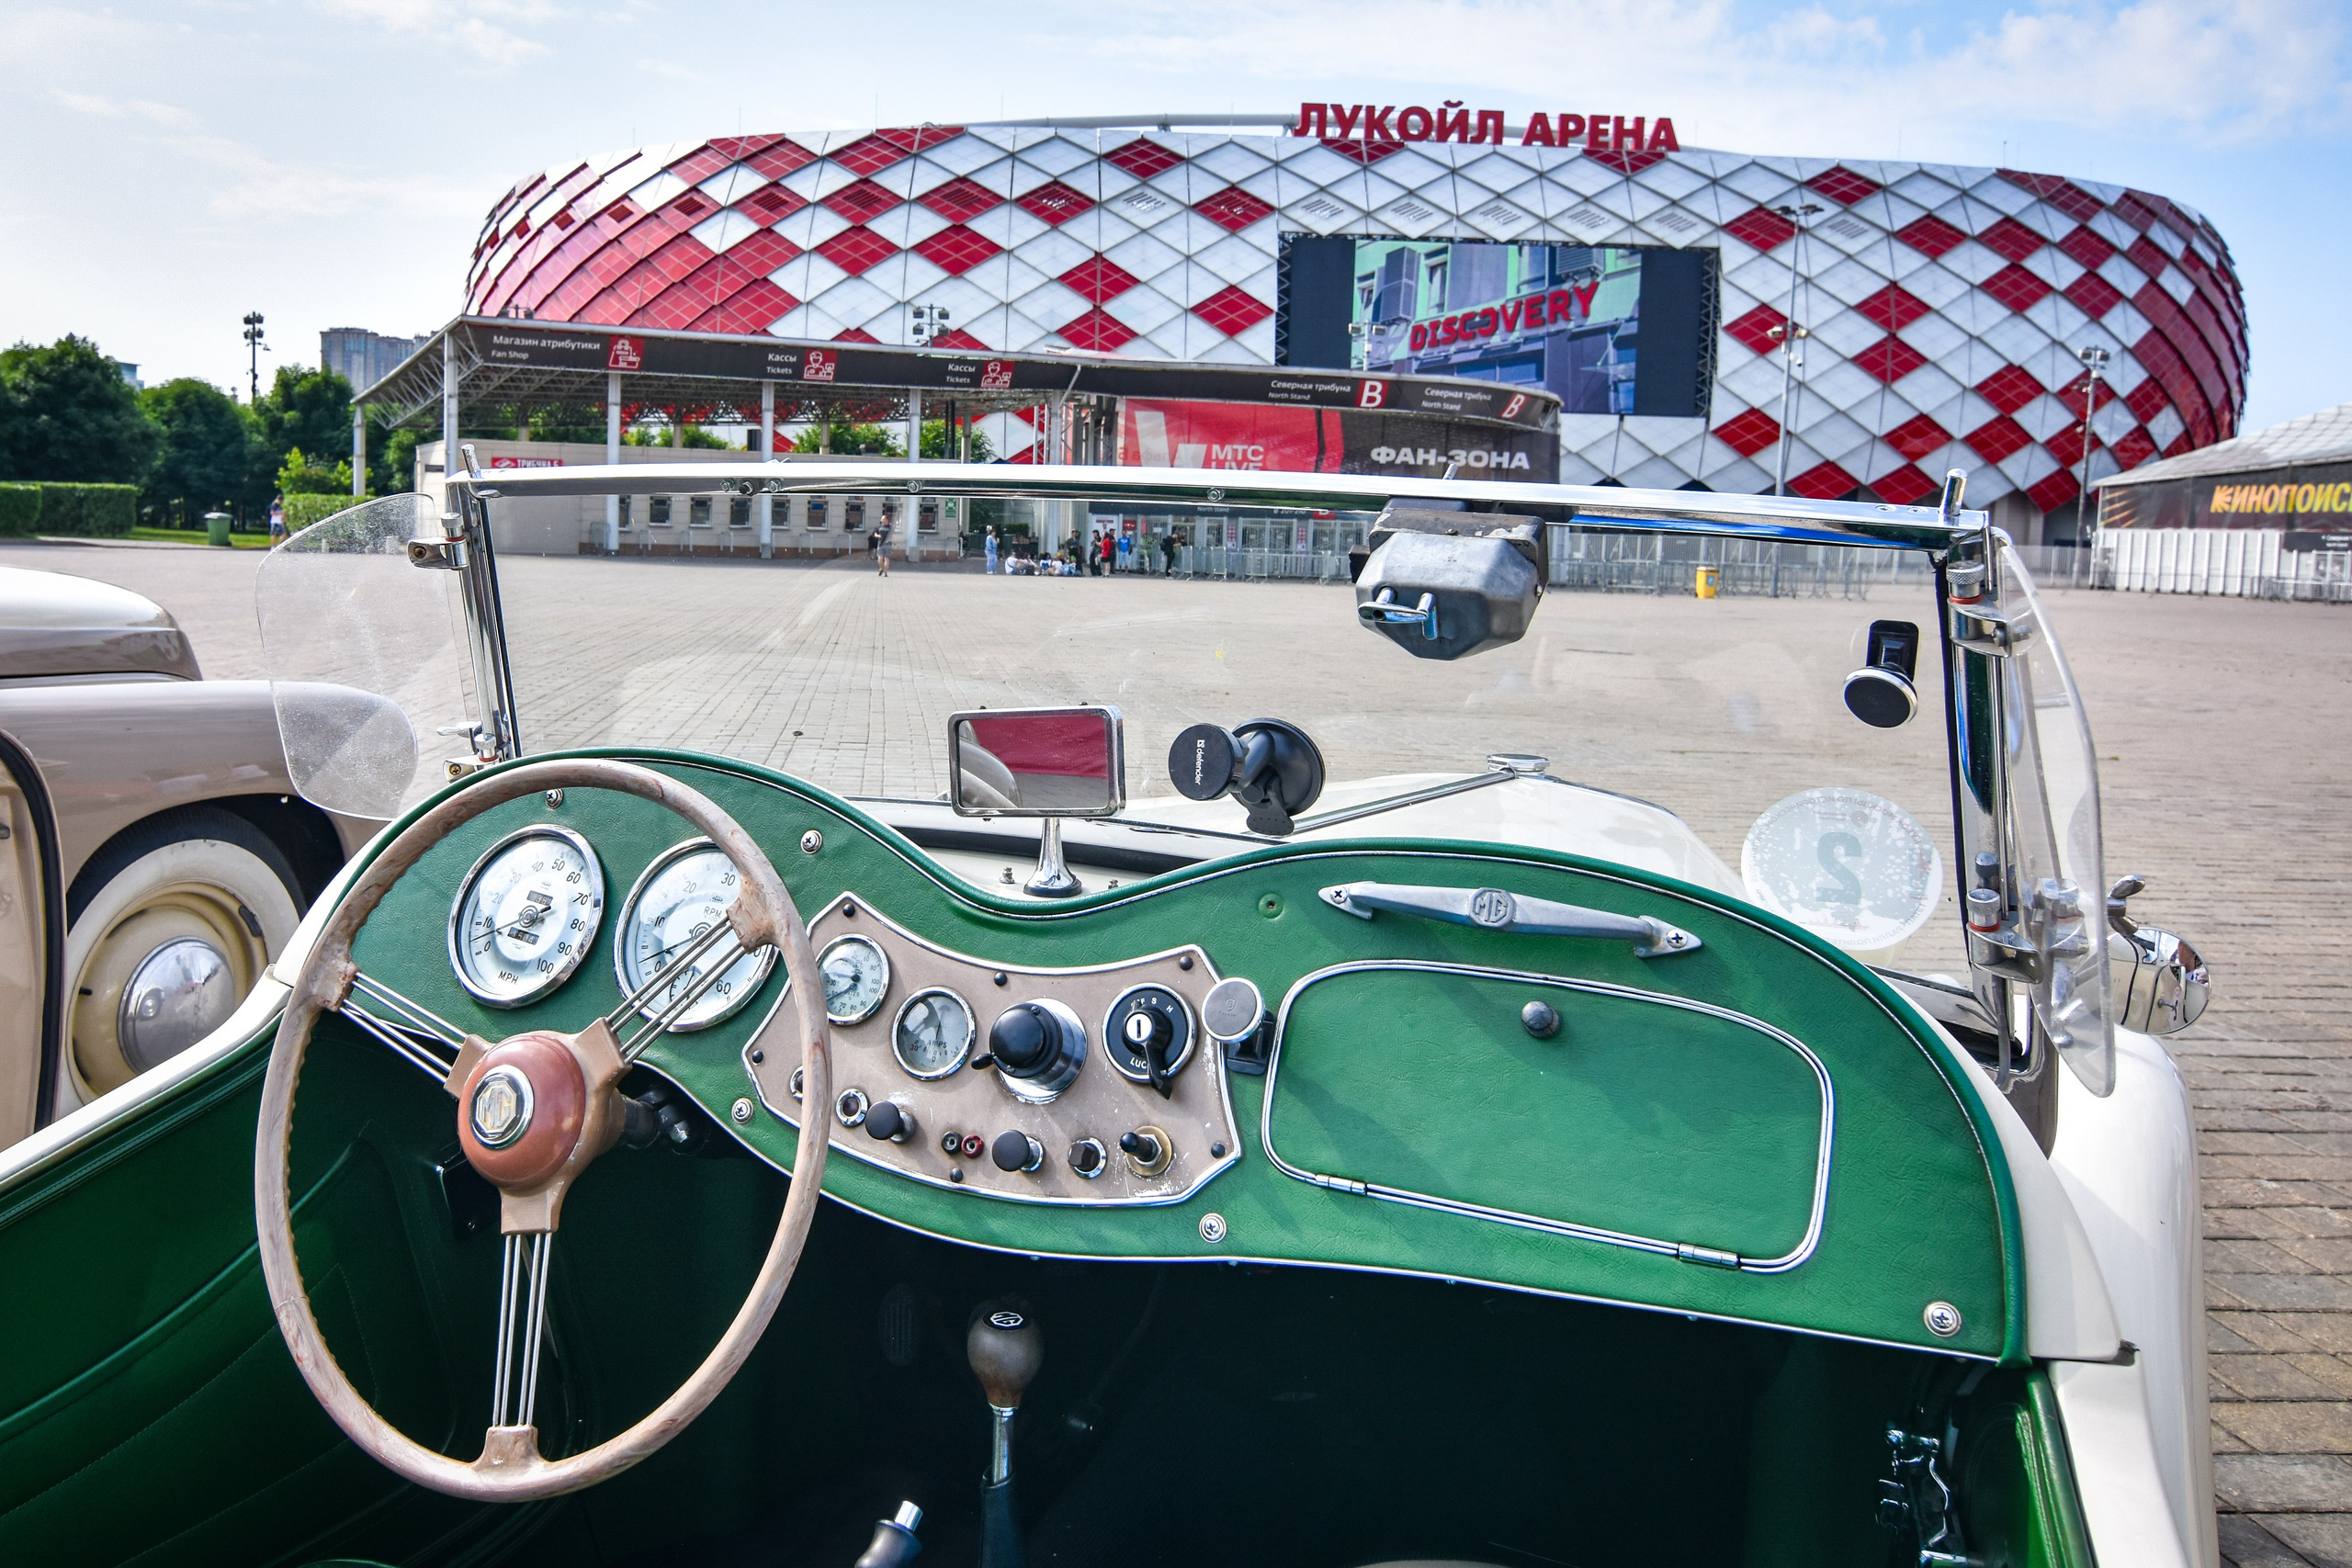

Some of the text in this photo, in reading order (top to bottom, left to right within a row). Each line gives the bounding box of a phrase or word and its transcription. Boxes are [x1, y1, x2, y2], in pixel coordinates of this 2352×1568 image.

[1294, 99, 1680, 152] ЛУКОЙЛ АРЕНА
[1409, 280, 1600, 352] DISCOVERY
[492, 335, 600, 351] Магазин атрибутики
[491, 350, 528, 360] Fan Shop
[768, 353, 797, 363] Кассы
[766, 367, 792, 375] Tickets
[947, 363, 976, 373] Кассы
[945, 376, 970, 384] Tickets
[1271, 379, 1351, 393] Северная трибуна
[1424, 388, 1492, 401] Северная трибуна
[1421, 400, 1461, 412] North Stand
[1371, 446, 1530, 469] ФАН-ЗОНА
[2210, 482, 2352, 513] КИНОПОИС
[1195, 748, 1204, 785] defender
[531, 861, 544, 872] 40
[552, 859, 565, 871] 50
[510, 872, 522, 884] 30
[566, 872, 581, 884] 60
[721, 873, 736, 886] 30
[683, 881, 696, 894] 20
[492, 892, 503, 905] 20
[572, 892, 588, 905] 70
[1475, 891, 1509, 924] MG
[482, 916, 492, 928] 10
[571, 919, 585, 931] 80
[654, 916, 665, 929] 10
[483, 941, 491, 952] 0
[557, 942, 572, 955] 90
[537, 958, 554, 974] 100
[654, 960, 662, 973] 0
[717, 979, 731, 995] 60
[1151, 997, 1157, 1005] S
[1166, 1005, 1174, 1013] H
[926, 1039, 947, 1049] AMPS
[481, 1087, 513, 1128] MG
